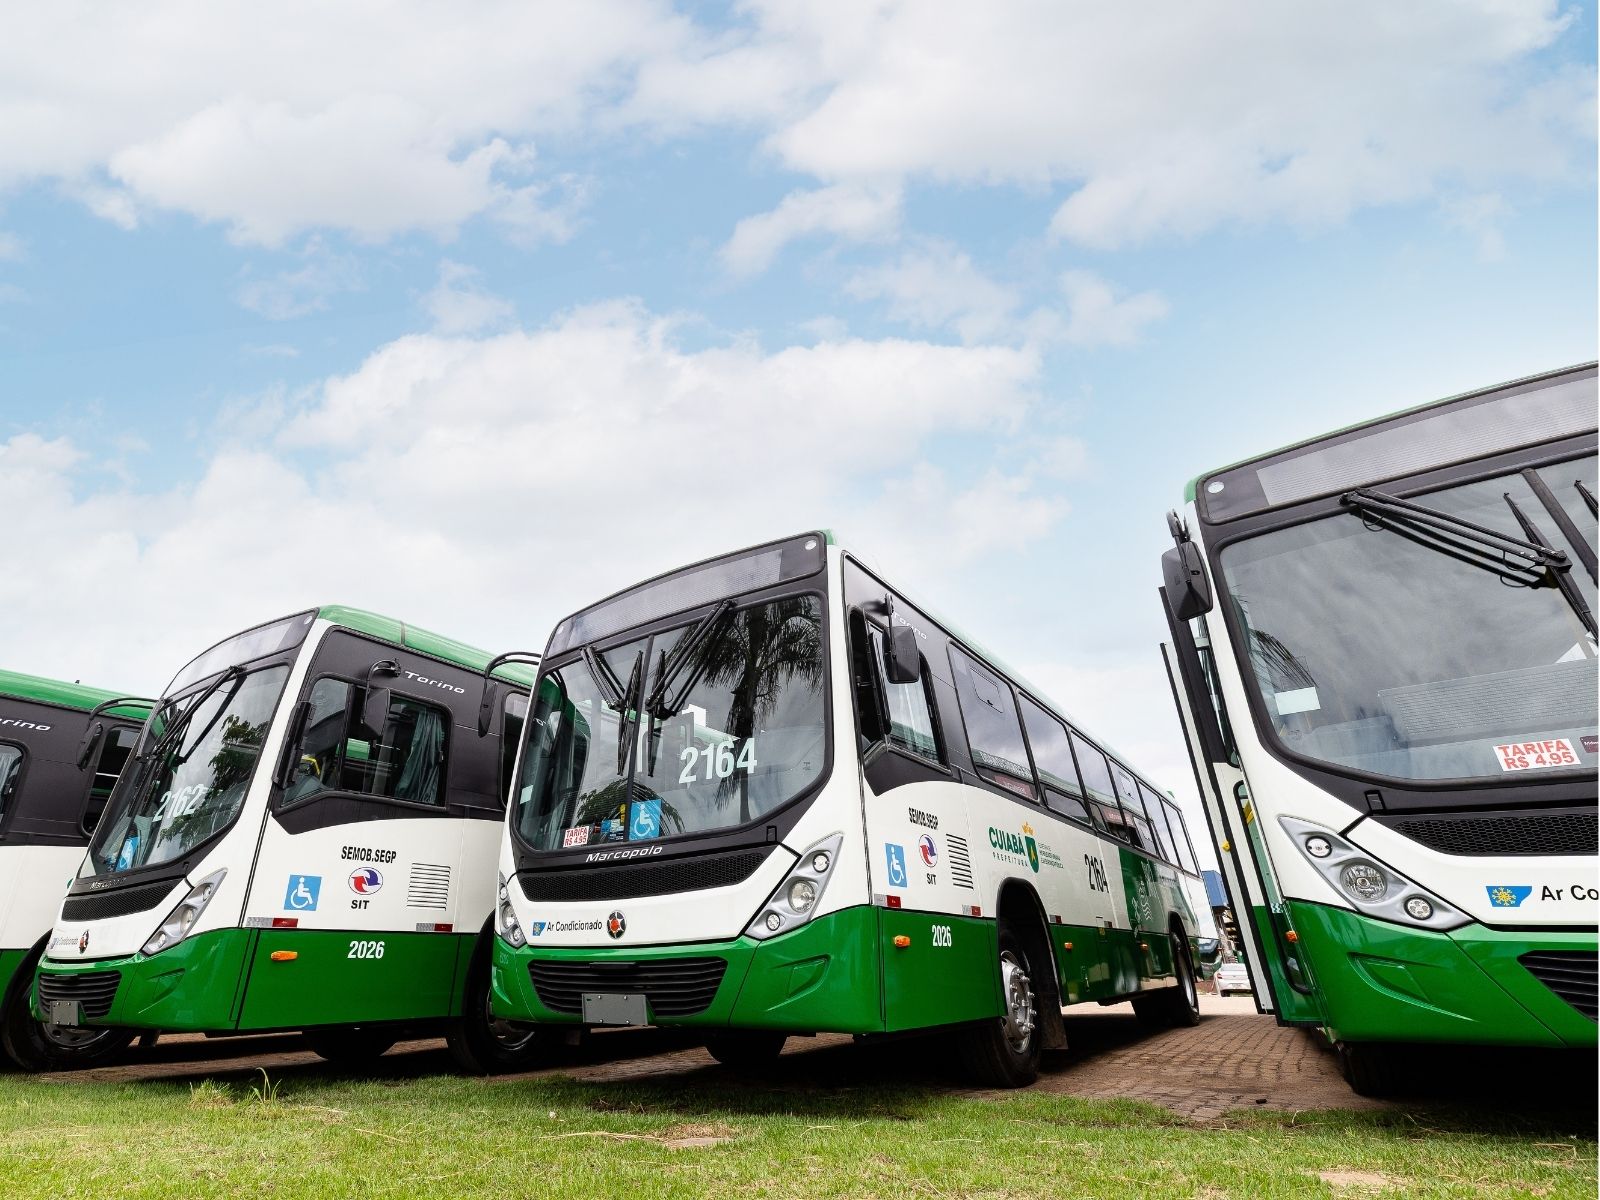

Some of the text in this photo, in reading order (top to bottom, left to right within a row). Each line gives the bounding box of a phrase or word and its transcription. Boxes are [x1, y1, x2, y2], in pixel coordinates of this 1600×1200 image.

[404, 670, 465, 694] Torino
[0, 718, 51, 731] rino
[1498, 740, 1570, 758] TARIFA
[679, 737, 758, 784] 2164
[1504, 751, 1575, 770] R$ 4,95
[152, 783, 205, 823] 2162
[566, 827, 588, 839] TARIFA
[341, 845, 397, 864] SEMOB.SEGP
[585, 845, 663, 863] Marcopolo
[926, 872, 937, 886] SIT
[1084, 853, 1109, 893] 2164
[1541, 885, 1564, 901] Ar
[350, 899, 370, 910] SIT
[547, 918, 603, 932] Ar Condicionado
[931, 924, 952, 948] 2026
[347, 940, 386, 960] 2026
